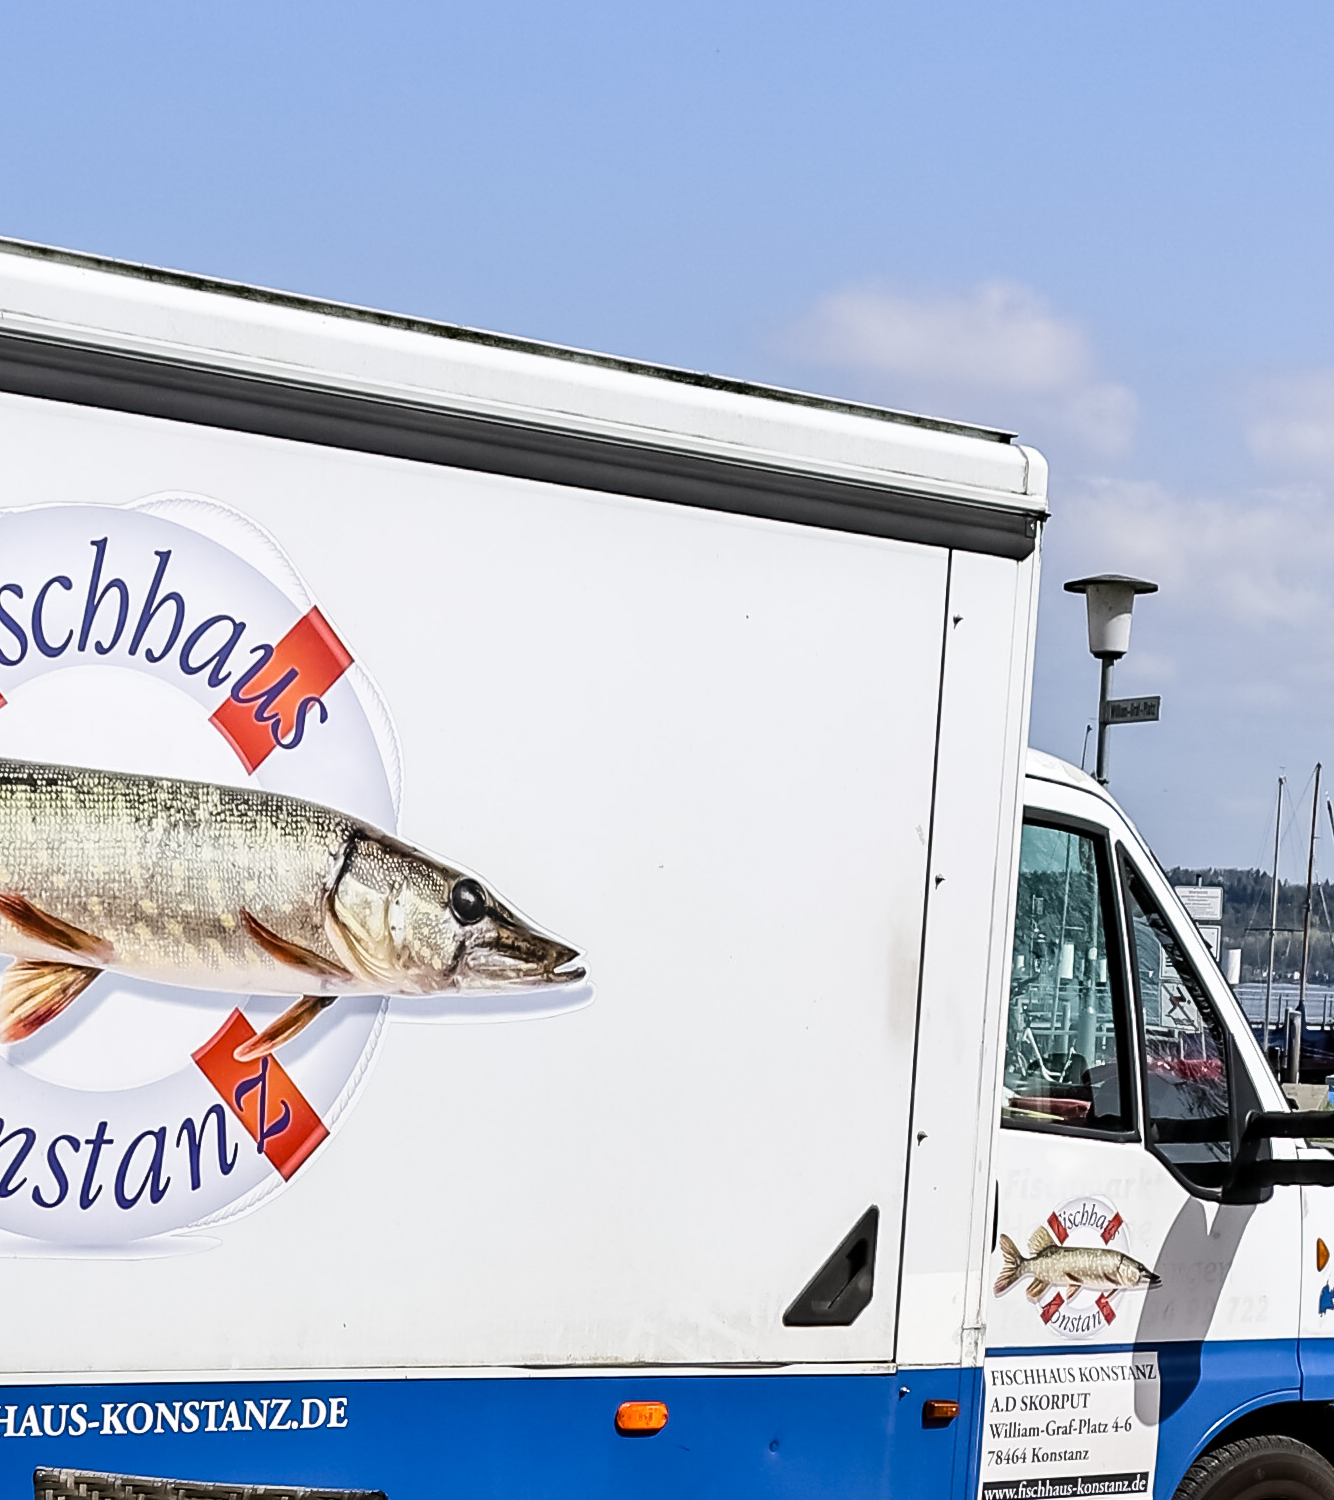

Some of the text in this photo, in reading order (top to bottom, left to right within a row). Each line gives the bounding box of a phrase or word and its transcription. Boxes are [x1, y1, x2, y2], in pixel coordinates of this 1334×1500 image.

[991, 1363, 1158, 1387] FISCHHAUS KONSTANZ
[989, 1392, 1091, 1413] A.D SKORPUT
[989, 1416, 1133, 1440] William-Graf-Platz 4-6
[987, 1447, 1090, 1467] 78464 Konstanz
[984, 1473, 1147, 1500] www.fischhaus-konstanz.de
